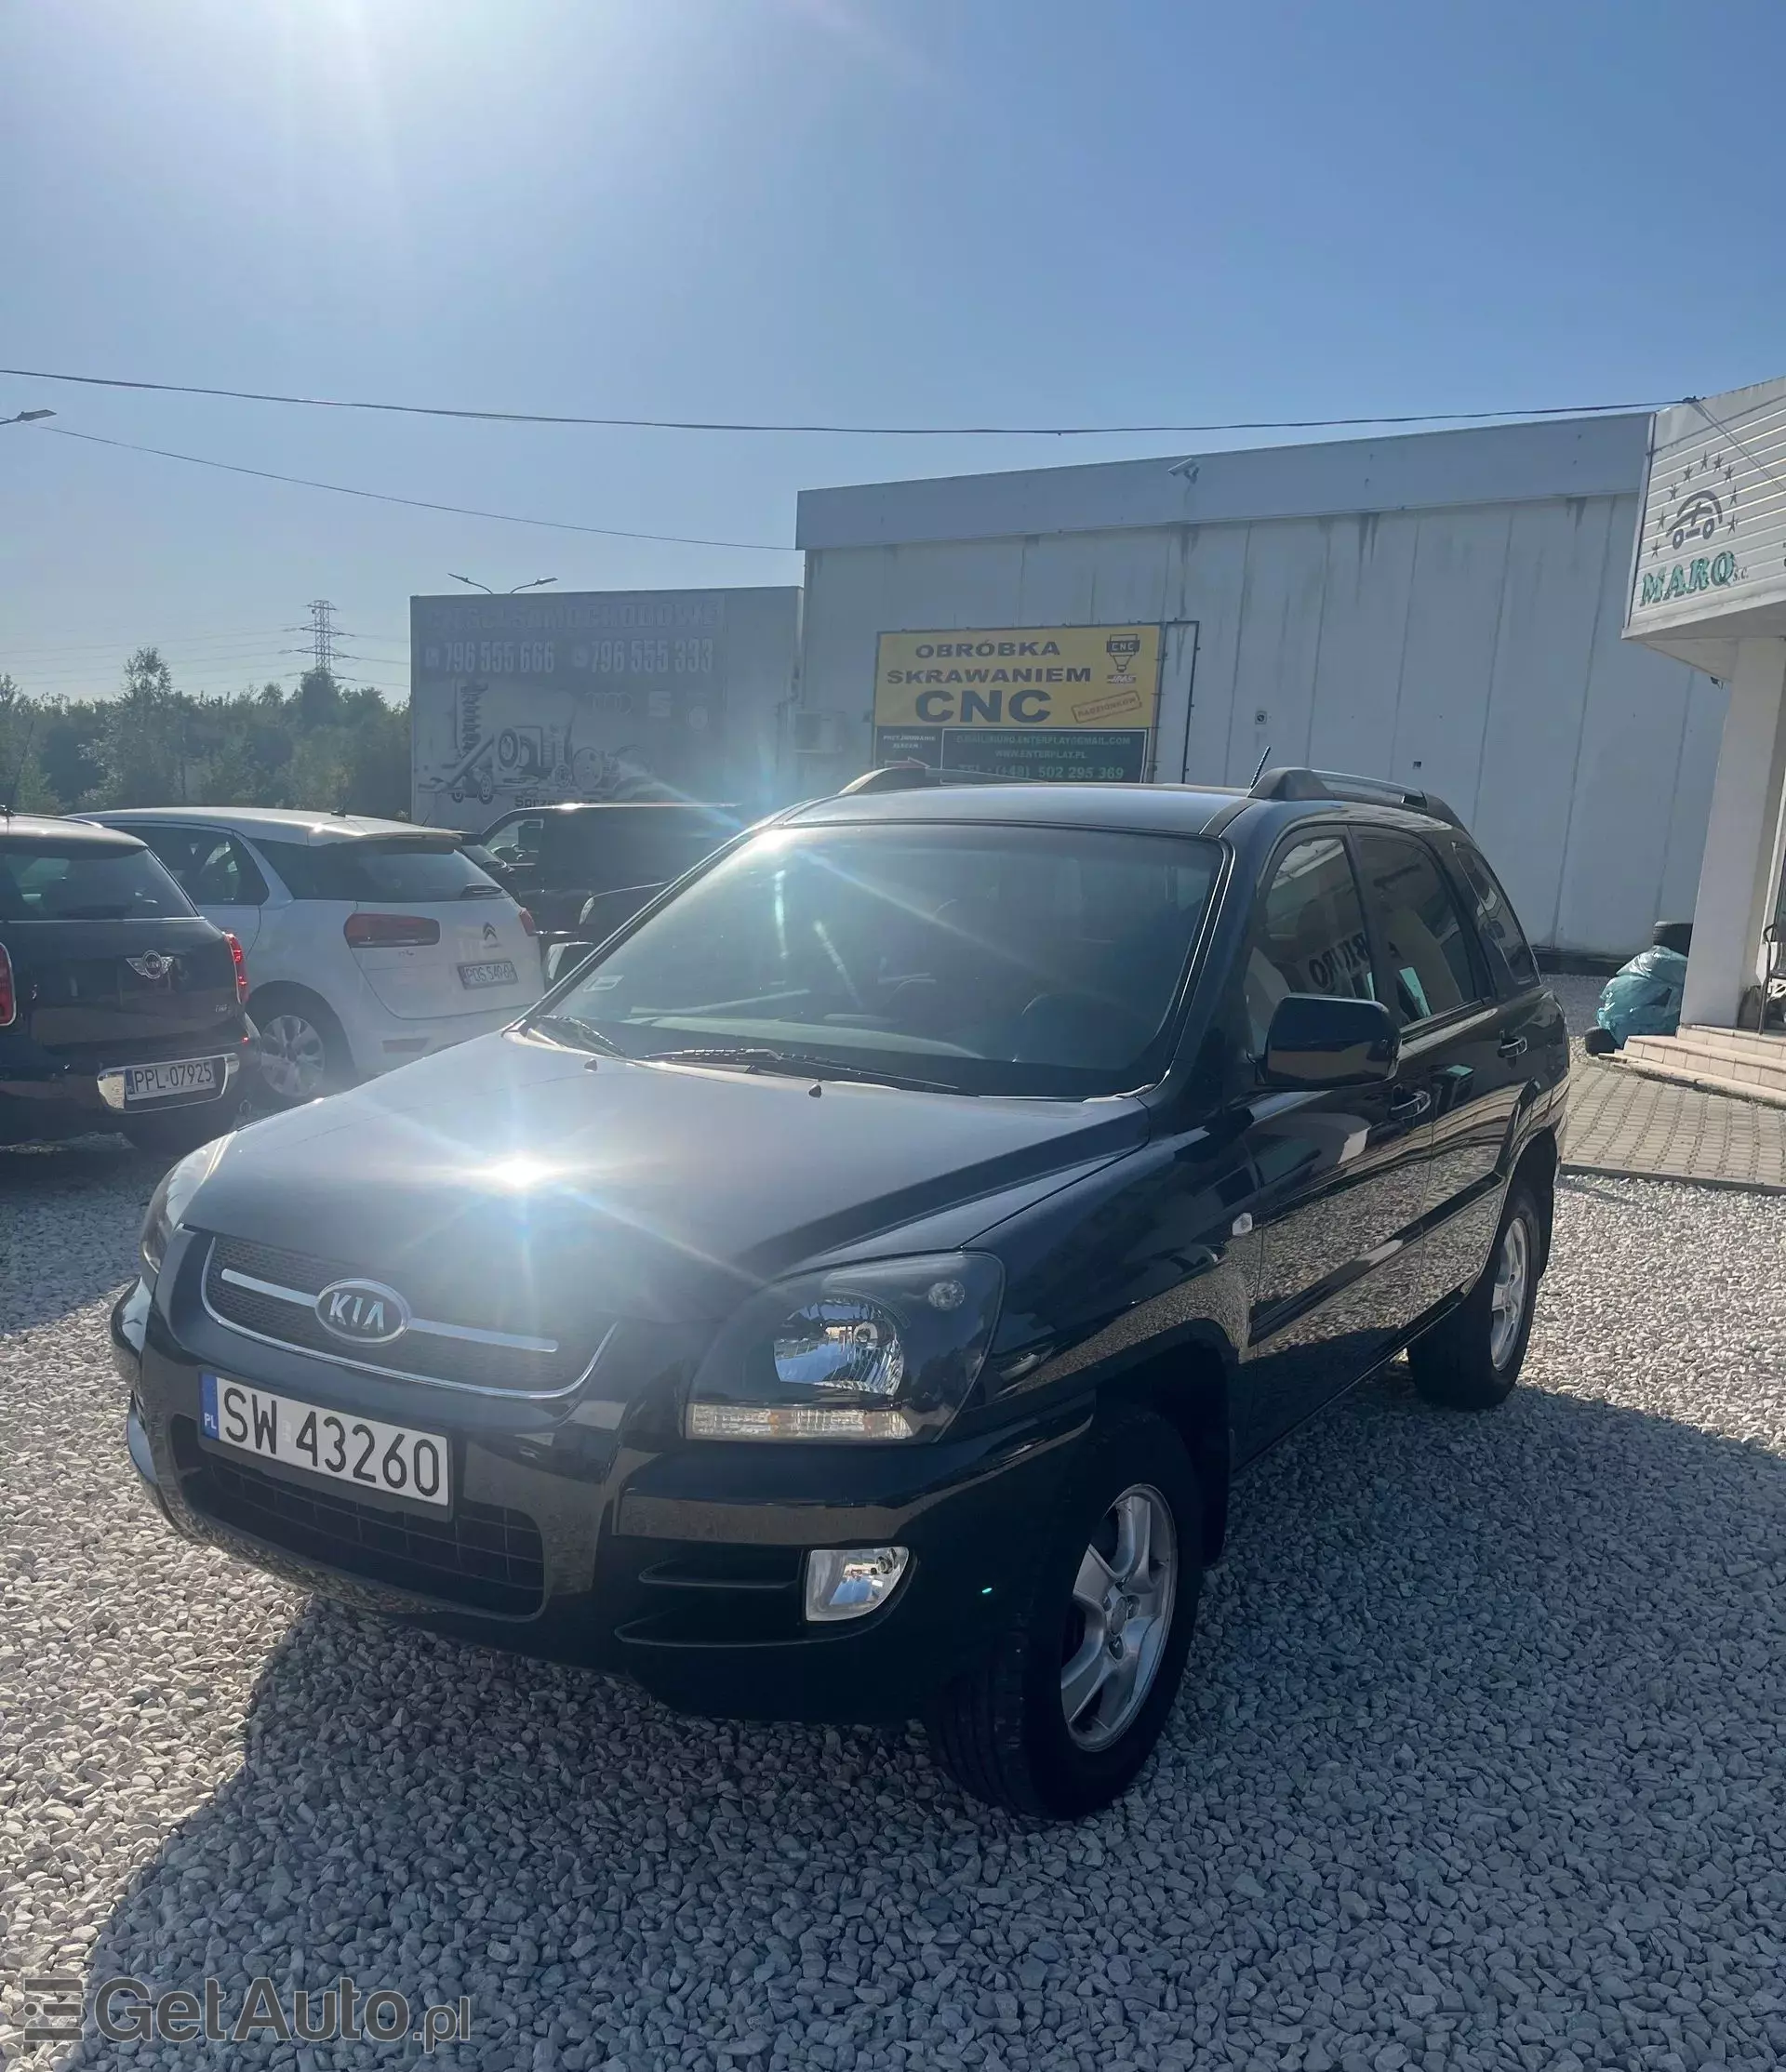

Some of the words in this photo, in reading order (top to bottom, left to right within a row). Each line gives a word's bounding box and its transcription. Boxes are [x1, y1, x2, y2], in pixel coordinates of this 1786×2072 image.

[445, 641, 475, 673] 796
[480, 641, 514, 673] 555
[519, 640, 554, 673] 666
[591, 639, 625, 673] 796
[630, 638, 668, 673] 555
[674, 637, 714, 672] 333
[915, 639, 1061, 659] OBRÓBKA
[1111, 642, 1135, 651] CNC
[886, 667, 1092, 685] SKRAWANIEM
[915, 689, 1052, 724] CNC
[1037, 765, 1063, 779] 502
[1068, 766, 1093, 779] 295
[1098, 766, 1125, 779] 369
[134, 1069, 167, 1092] PPL
[169, 1062, 212, 1086] 07925
[327, 1291, 385, 1335] KIA
[204, 1412, 218, 1431] PL
[222, 1387, 278, 1455] SW
[295, 1410, 440, 1497] 43260
